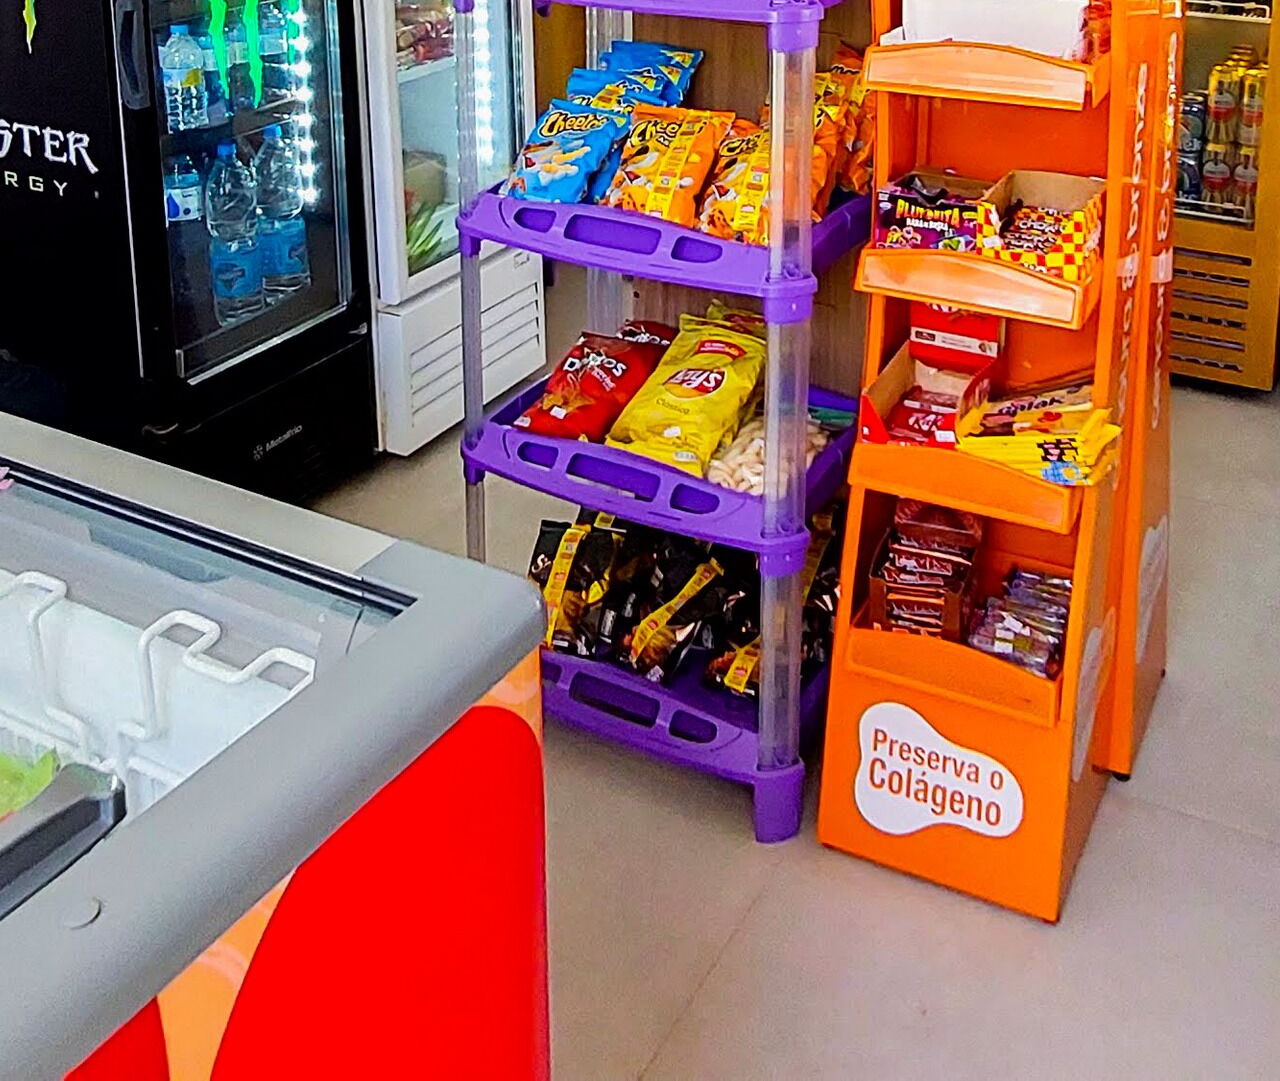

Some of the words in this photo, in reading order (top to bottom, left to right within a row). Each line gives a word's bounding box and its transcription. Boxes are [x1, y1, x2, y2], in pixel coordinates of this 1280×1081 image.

[1125, 62, 1148, 241] bronze
[868, 756, 1003, 828] Colágeno
[872, 728, 980, 784] Preserva
[989, 769, 1005, 792] o
